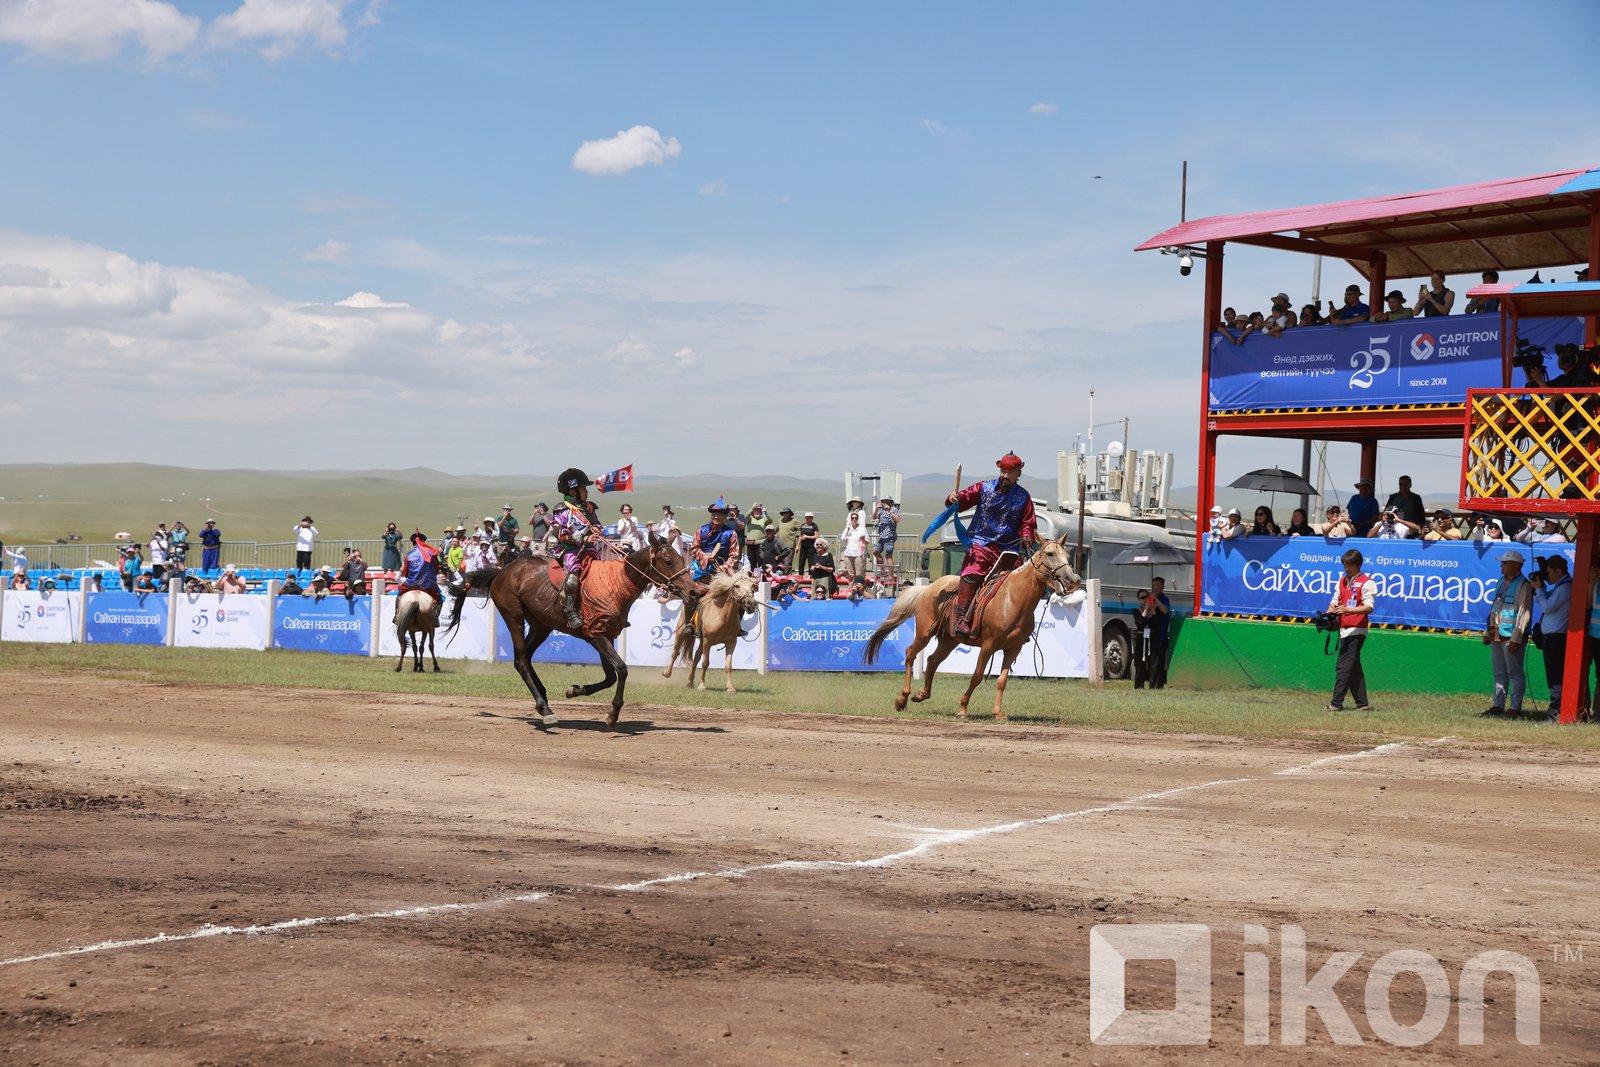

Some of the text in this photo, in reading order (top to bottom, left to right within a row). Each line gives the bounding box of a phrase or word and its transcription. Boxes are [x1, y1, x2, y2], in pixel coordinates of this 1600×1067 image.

[1438, 330, 1499, 345] CAPITRON
[1273, 353, 1336, 364] Өнөд дэвжих,
[1438, 346, 1470, 357] BANK
[1349, 334, 1391, 389] 25
[1260, 367, 1336, 378] өсөлтийн түүчээ
[1409, 377, 1448, 387] since 2001
[1300, 552, 1334, 564] Өөдлөн
[1376, 555, 1405, 566] Өргөн
[1407, 557, 1459, 568] түмнээрээ
[1242, 559, 1499, 614] Сайхан аадаара
[650, 617, 673, 649] 25
[782, 626, 827, 641] Сайхан
